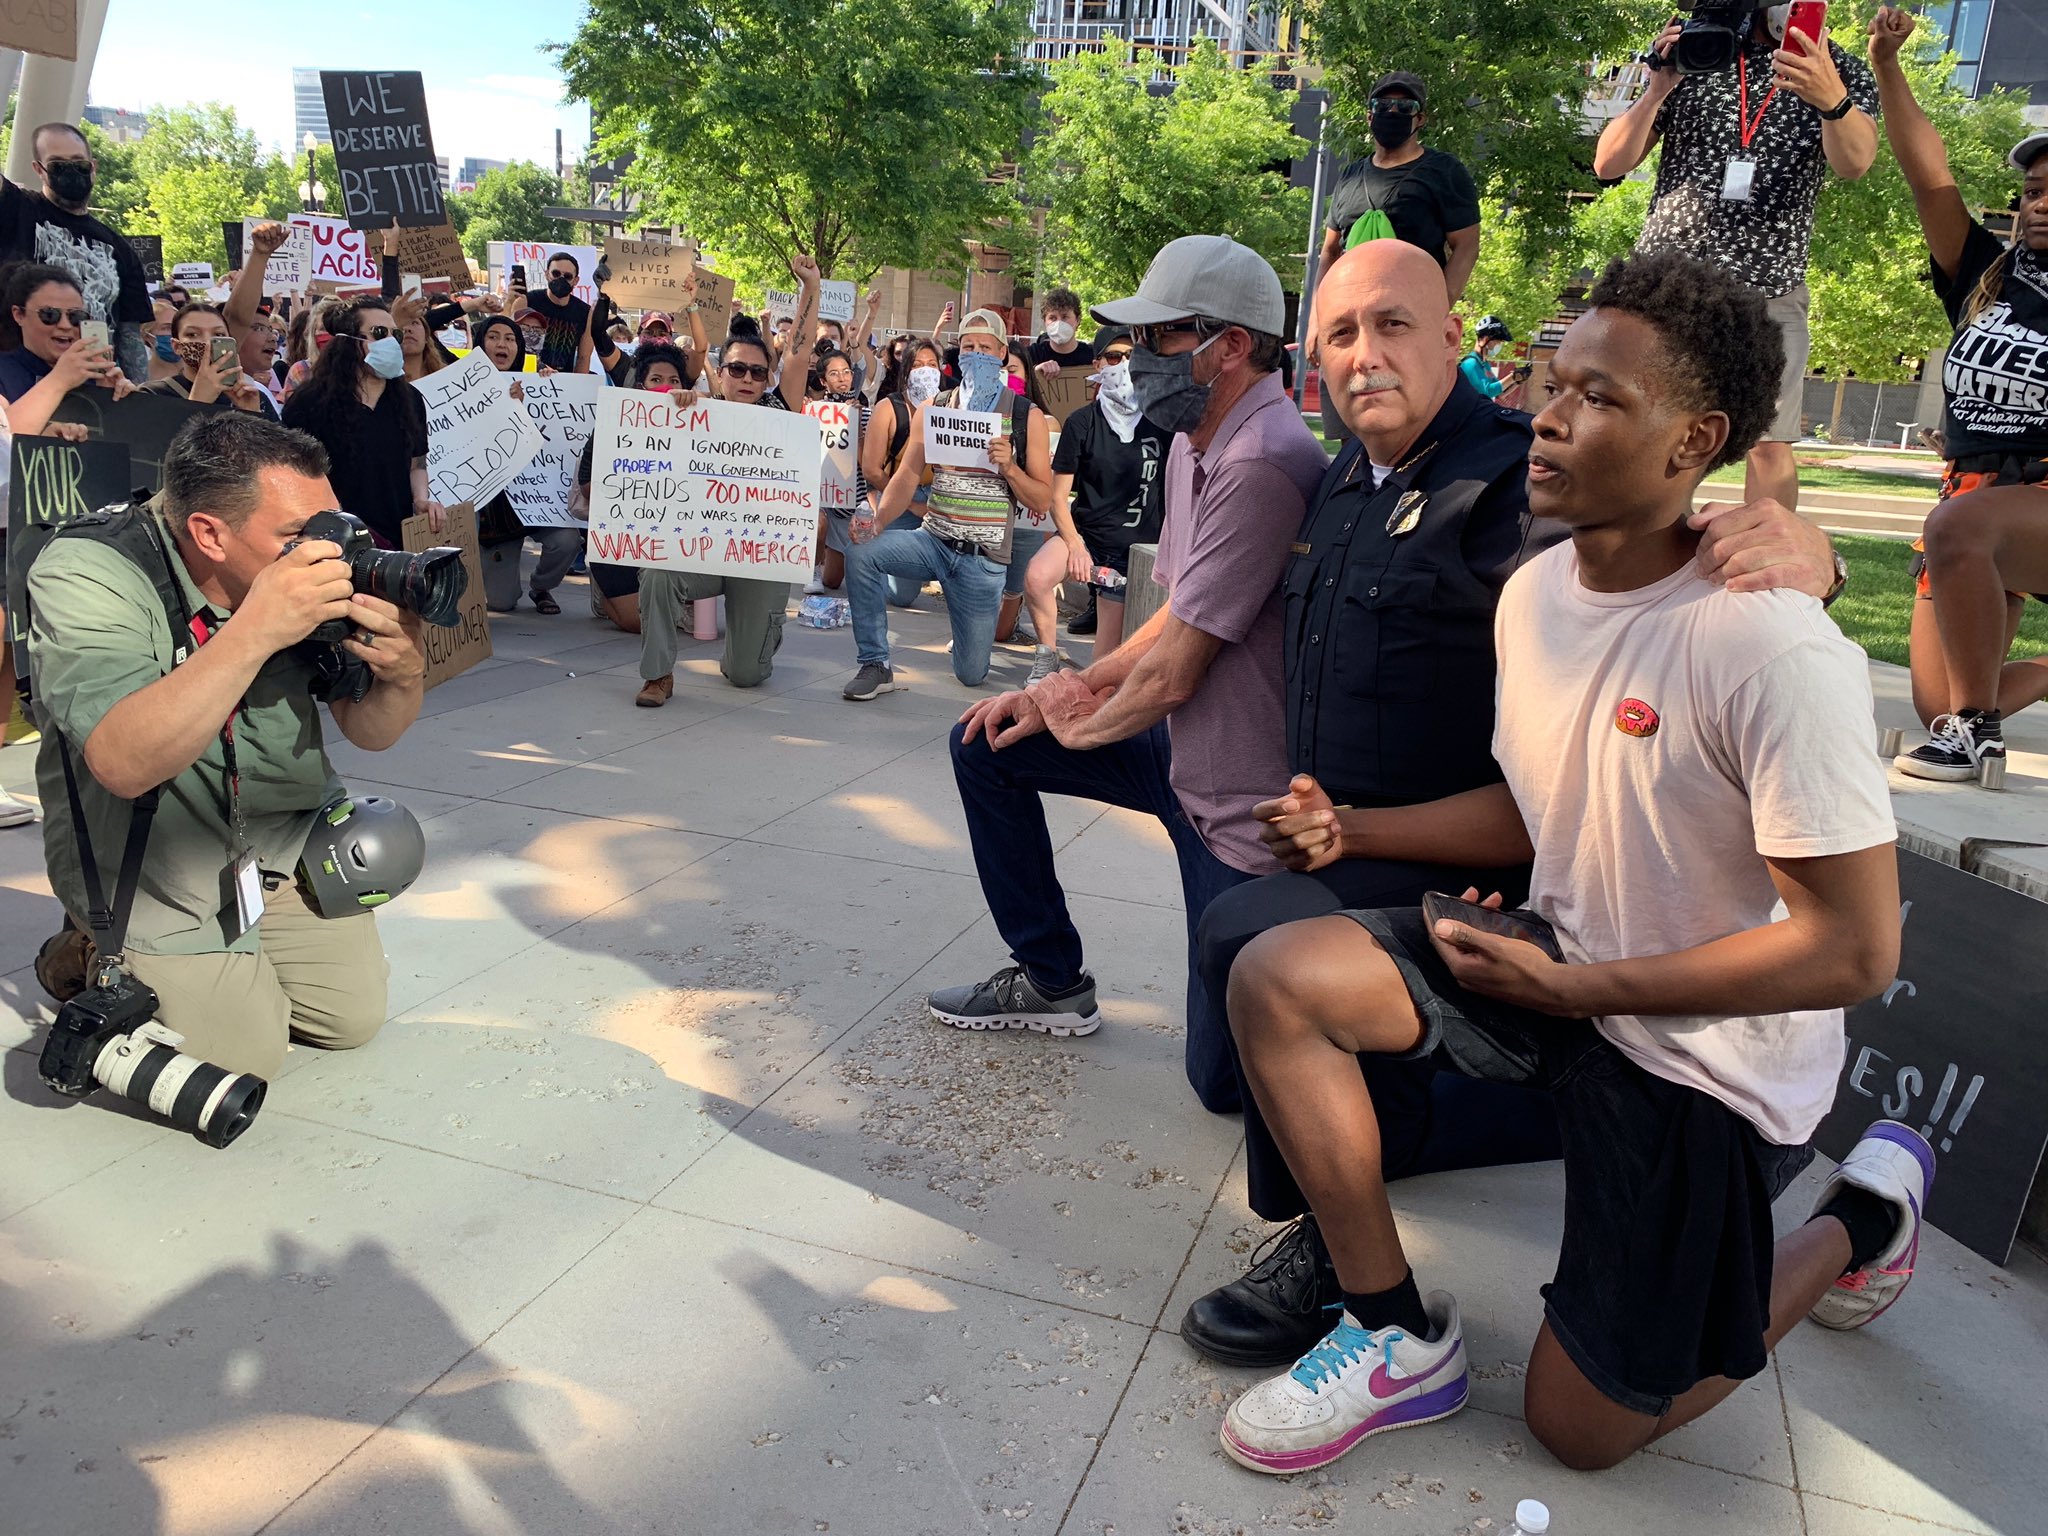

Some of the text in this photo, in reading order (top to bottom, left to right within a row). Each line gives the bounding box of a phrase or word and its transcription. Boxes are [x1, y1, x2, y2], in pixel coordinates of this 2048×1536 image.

[343, 73, 405, 116] WE
[334, 124, 427, 152] DESERVE
[340, 162, 443, 217] BETTER
[513, 244, 546, 262] END
[621, 242, 673, 257] BLACK
[312, 252, 382, 281] ACIS
[629, 262, 670, 275] LIVES
[621, 275, 676, 288] MATTER
[1972, 302, 2048, 344] BLAC
[422, 361, 491, 409] LIVES
[1944, 361, 2044, 411] MATTER
[427, 414, 455, 436] and
[619, 399, 710, 432] RACISM
[930, 415, 993, 436] NO JUSTICE,
[617, 434, 784, 458] IS AN IGNORANCE
[936, 433, 951, 446] NO
[18, 442, 91, 525] YOUR
[613, 458, 799, 481] PROBLEM OUR GOVERMENT
[603, 473, 812, 508] SPENDS 700 MILLIONS
[820, 477, 854, 505] tter
[610, 504, 814, 530] a day ON WARS FOR PROFITS
[590, 530, 812, 568] WAKE UP AMERICA
